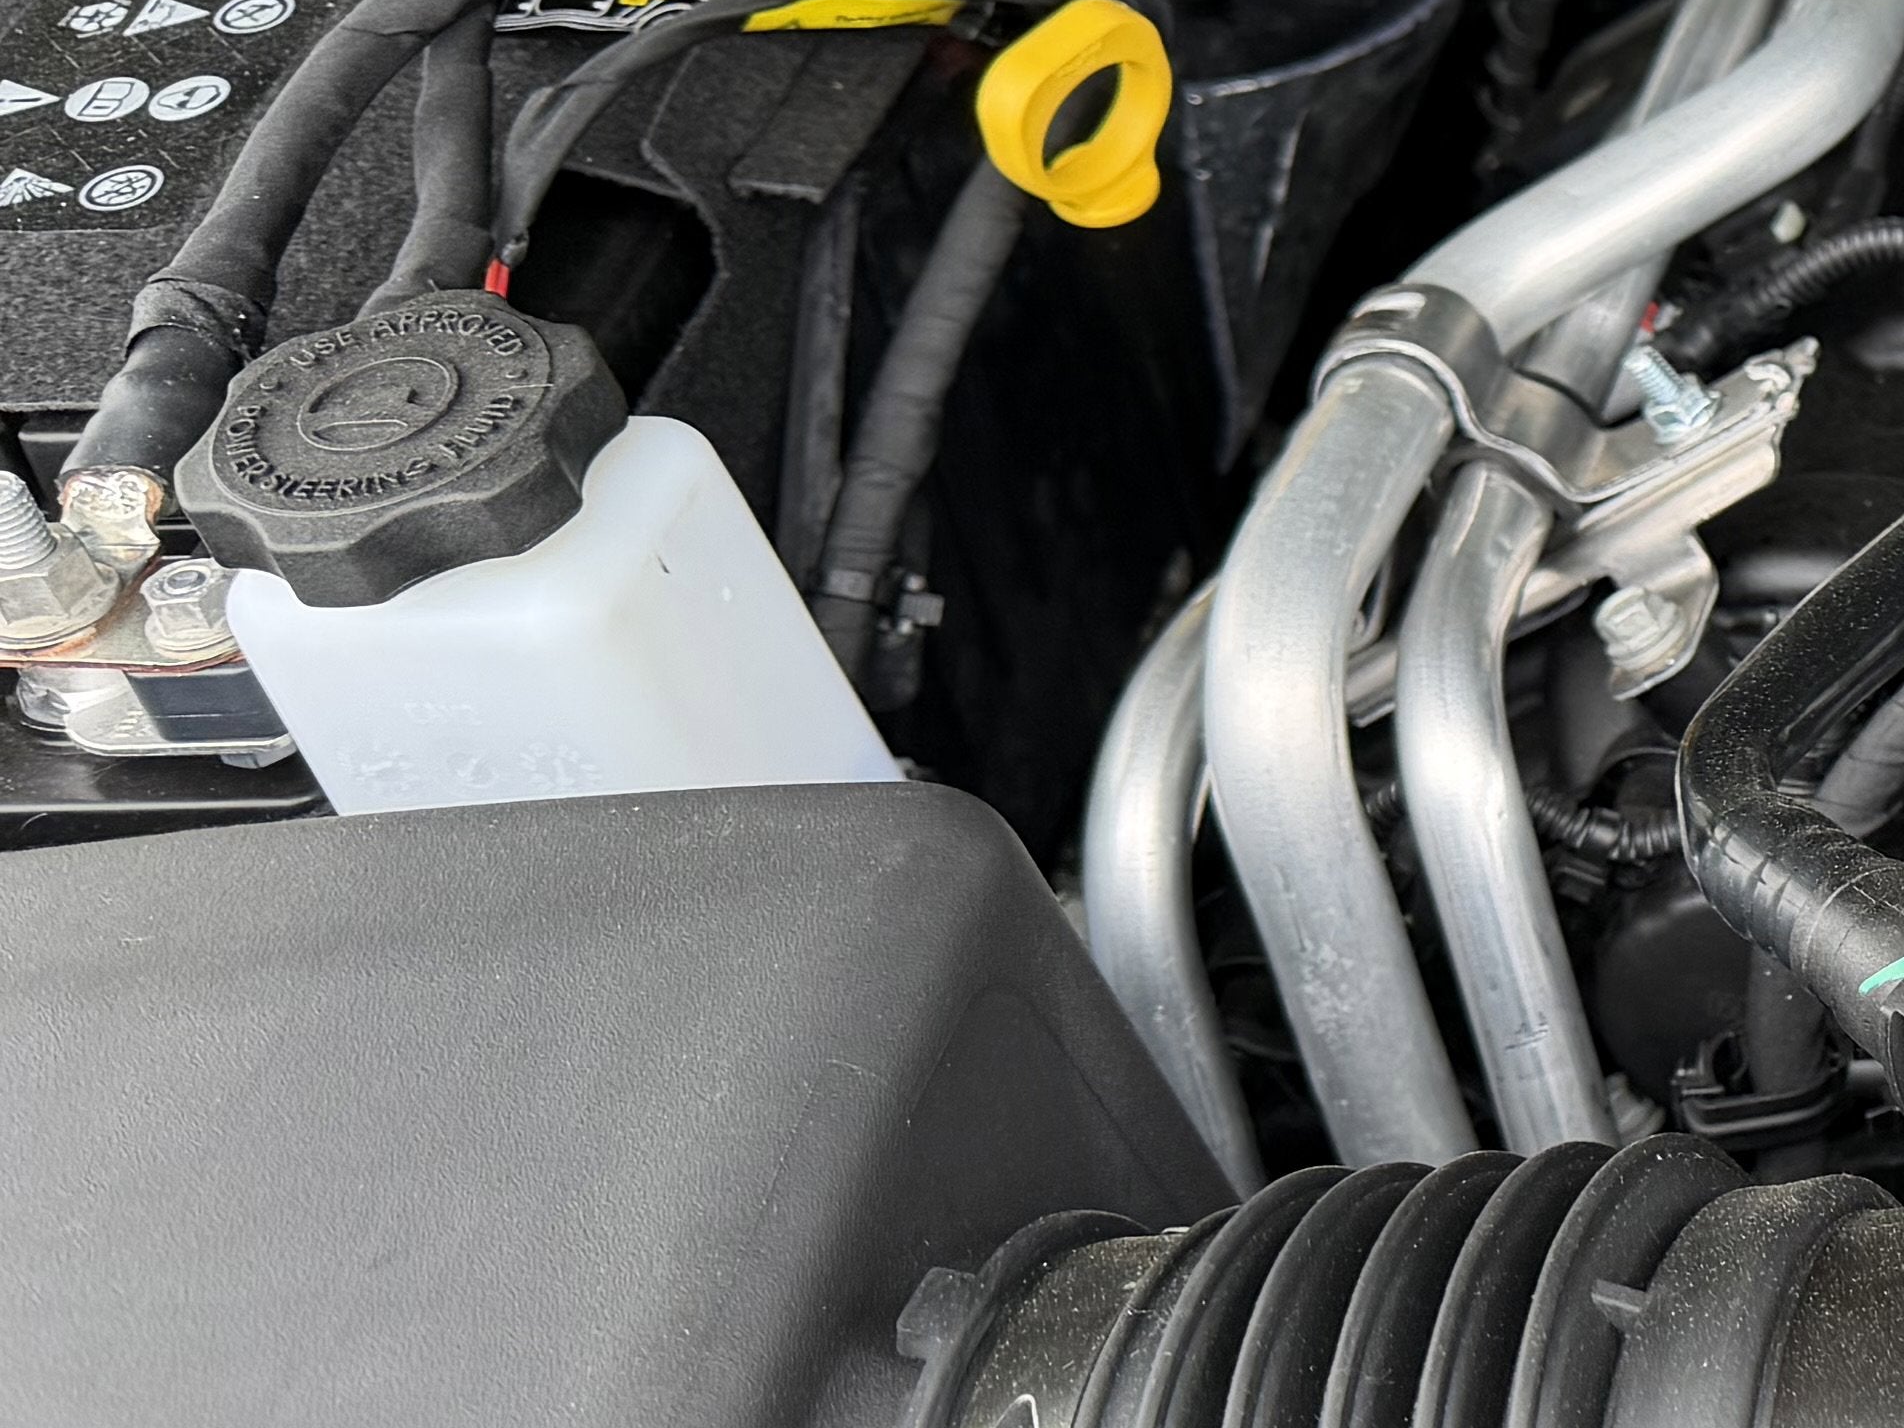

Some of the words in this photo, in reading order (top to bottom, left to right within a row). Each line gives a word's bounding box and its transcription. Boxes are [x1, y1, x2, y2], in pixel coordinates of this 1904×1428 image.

[290, 328, 356, 372] USE
[370, 310, 525, 358] APPROVED
[225, 404, 272, 479] POWER
[260, 456, 437, 503] STEERING
[439, 394, 518, 461] FLUID
